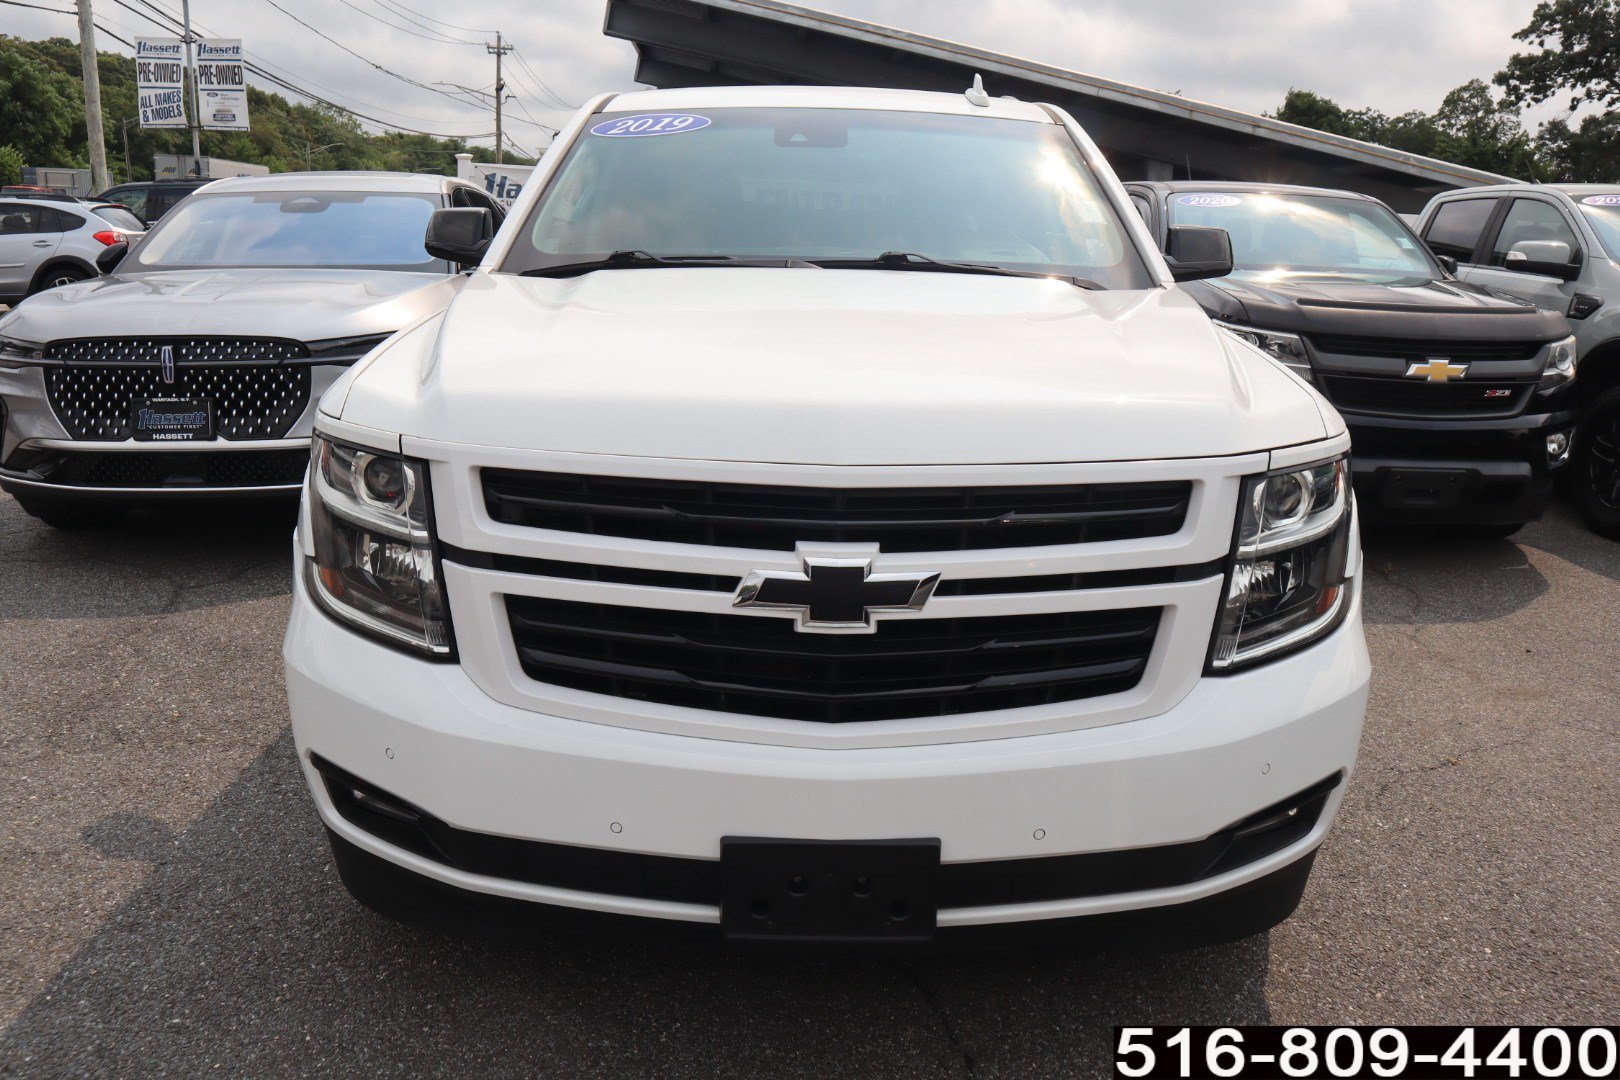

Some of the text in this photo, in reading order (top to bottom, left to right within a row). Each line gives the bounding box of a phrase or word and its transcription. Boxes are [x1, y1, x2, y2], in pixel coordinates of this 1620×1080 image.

[138, 62, 182, 83] PRE-OWNED
[198, 64, 244, 85] PRE-OWNED
[140, 90, 182, 109] ALL MAKES
[142, 104, 183, 122] & MODELS
[607, 117, 694, 135] 2019
[1190, 196, 1231, 205] 2020
